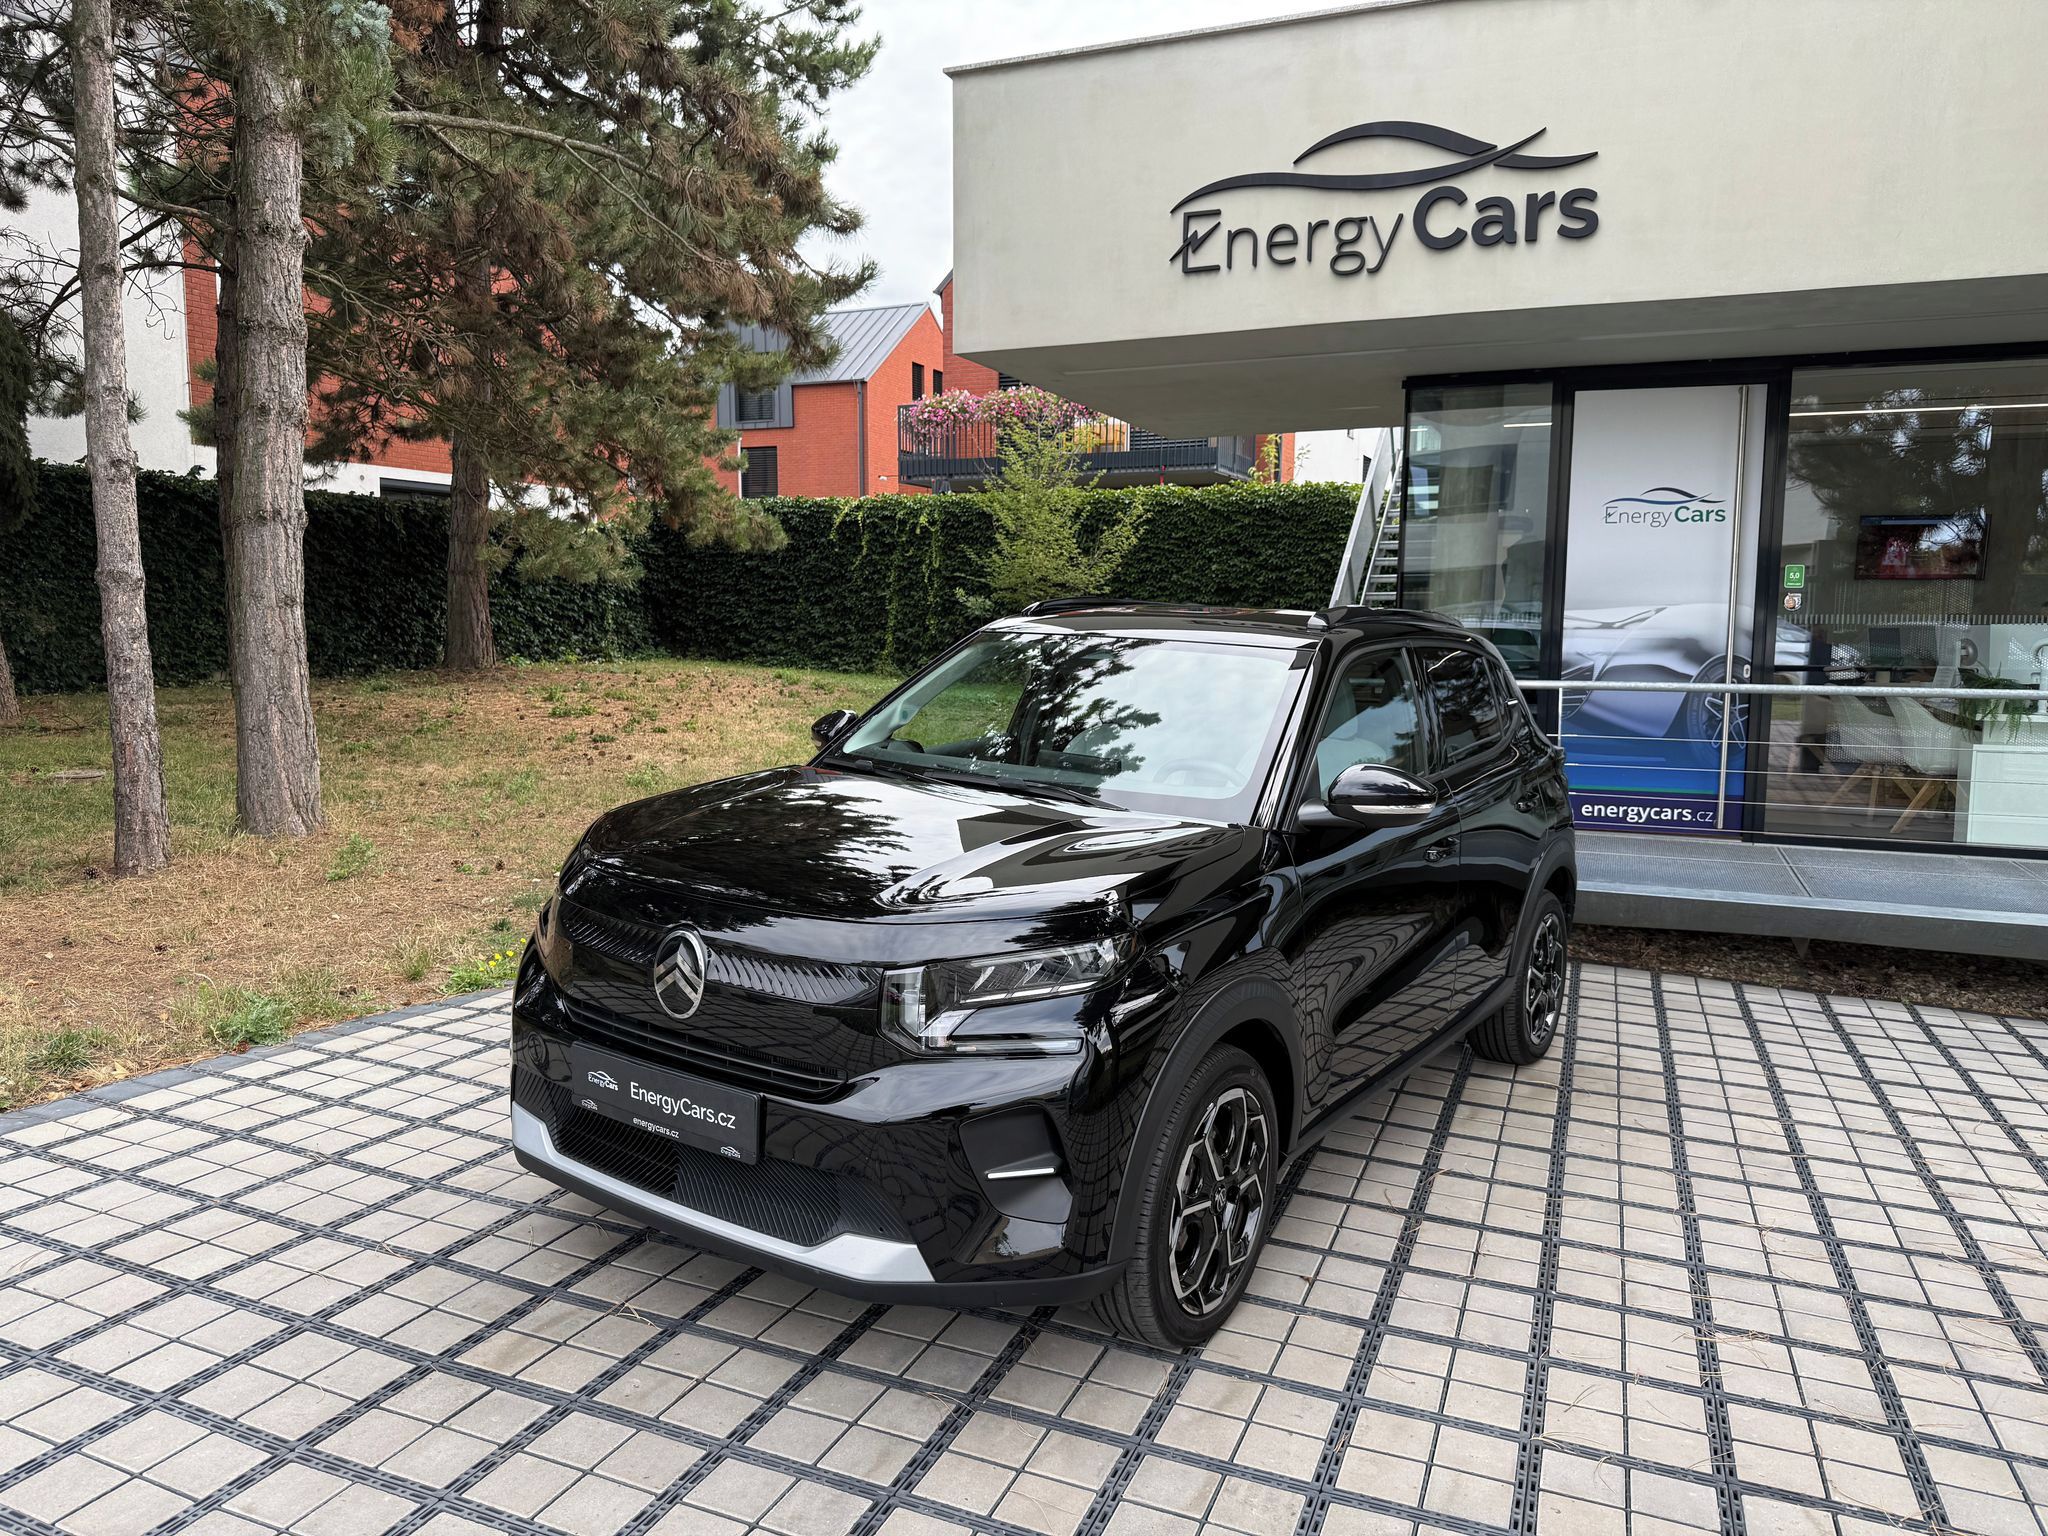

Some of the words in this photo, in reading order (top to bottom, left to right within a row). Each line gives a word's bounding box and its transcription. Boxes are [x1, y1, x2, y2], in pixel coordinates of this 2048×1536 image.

[1169, 185, 1599, 276] EnergyCars
[1603, 505, 1727, 528] EnergyCars
[1581, 804, 1714, 823] energycars.cz
[630, 1081, 736, 1130] EnergyCars.cz
[632, 1117, 680, 1139] energycars.cz
